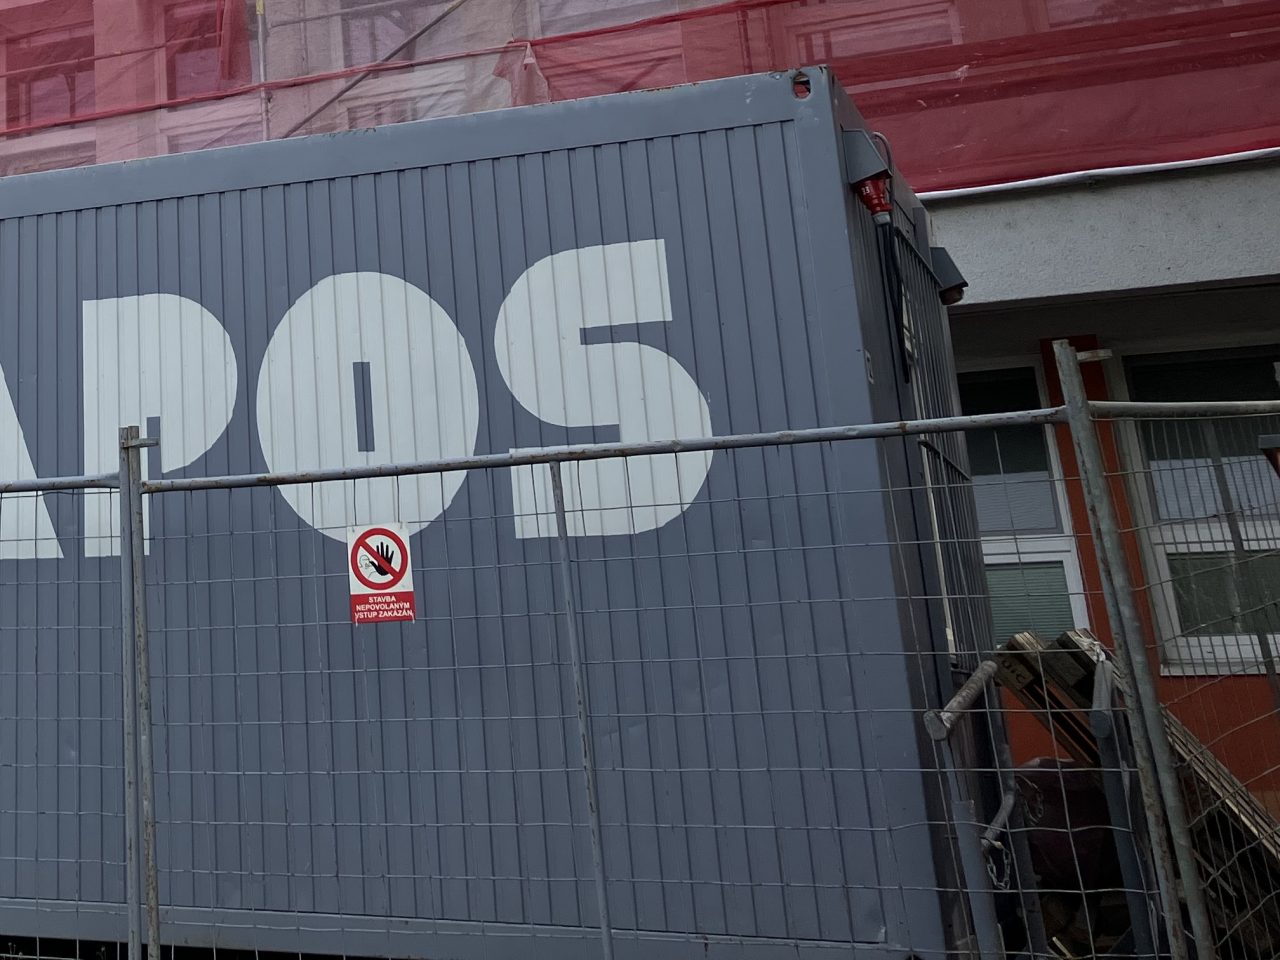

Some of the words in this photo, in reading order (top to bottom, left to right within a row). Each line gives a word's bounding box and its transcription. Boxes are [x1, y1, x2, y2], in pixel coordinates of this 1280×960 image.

[368, 595, 397, 603] STAVBA
[355, 601, 410, 611] NEPOVOLANÝM
[355, 611, 378, 619] VSTUP
